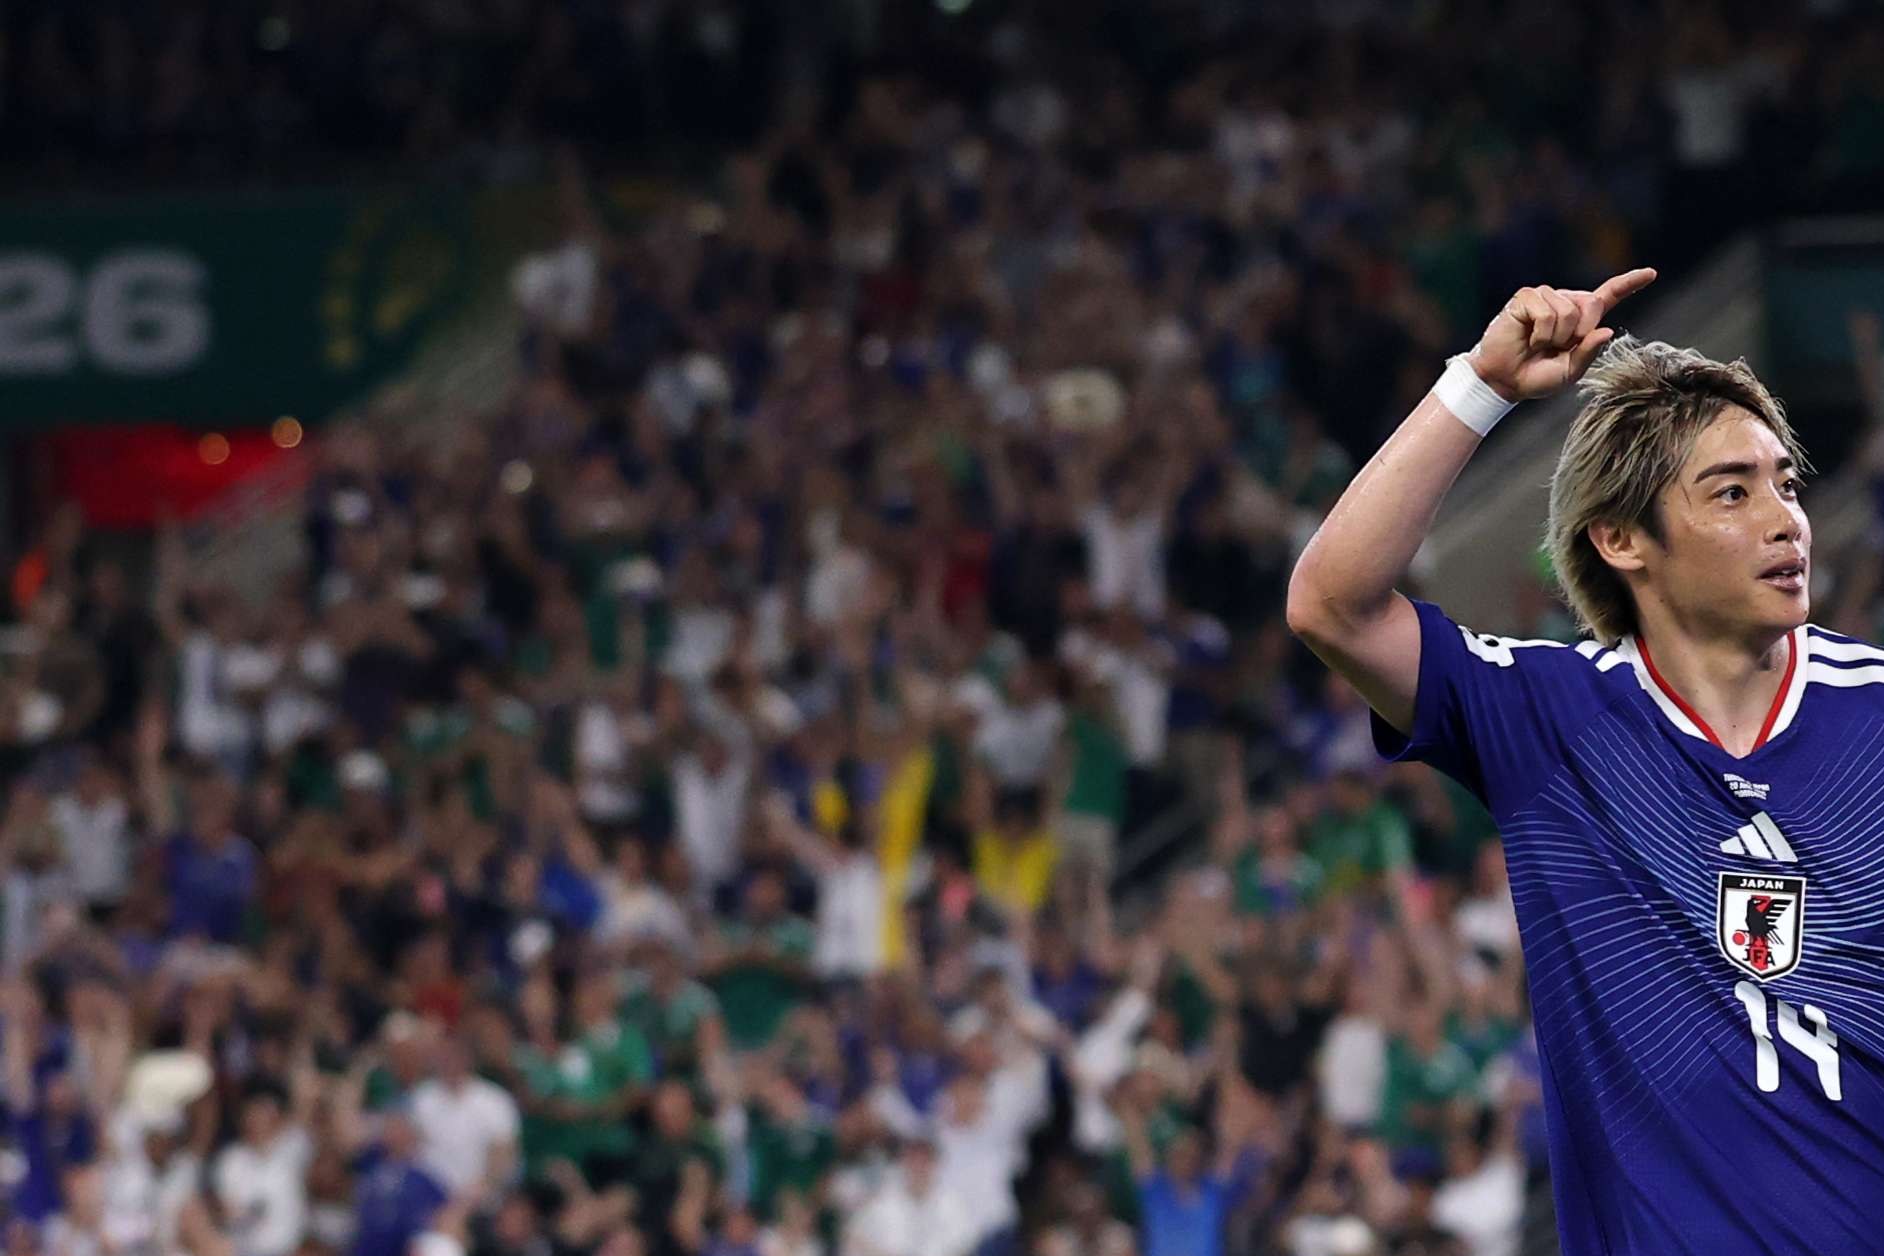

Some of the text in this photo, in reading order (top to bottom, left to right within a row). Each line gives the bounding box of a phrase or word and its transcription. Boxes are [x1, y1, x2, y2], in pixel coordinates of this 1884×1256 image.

[1739, 878, 1785, 891] JAPAN
[1742, 948, 1777, 967] JFA
[1734, 980, 1843, 1102] 14
